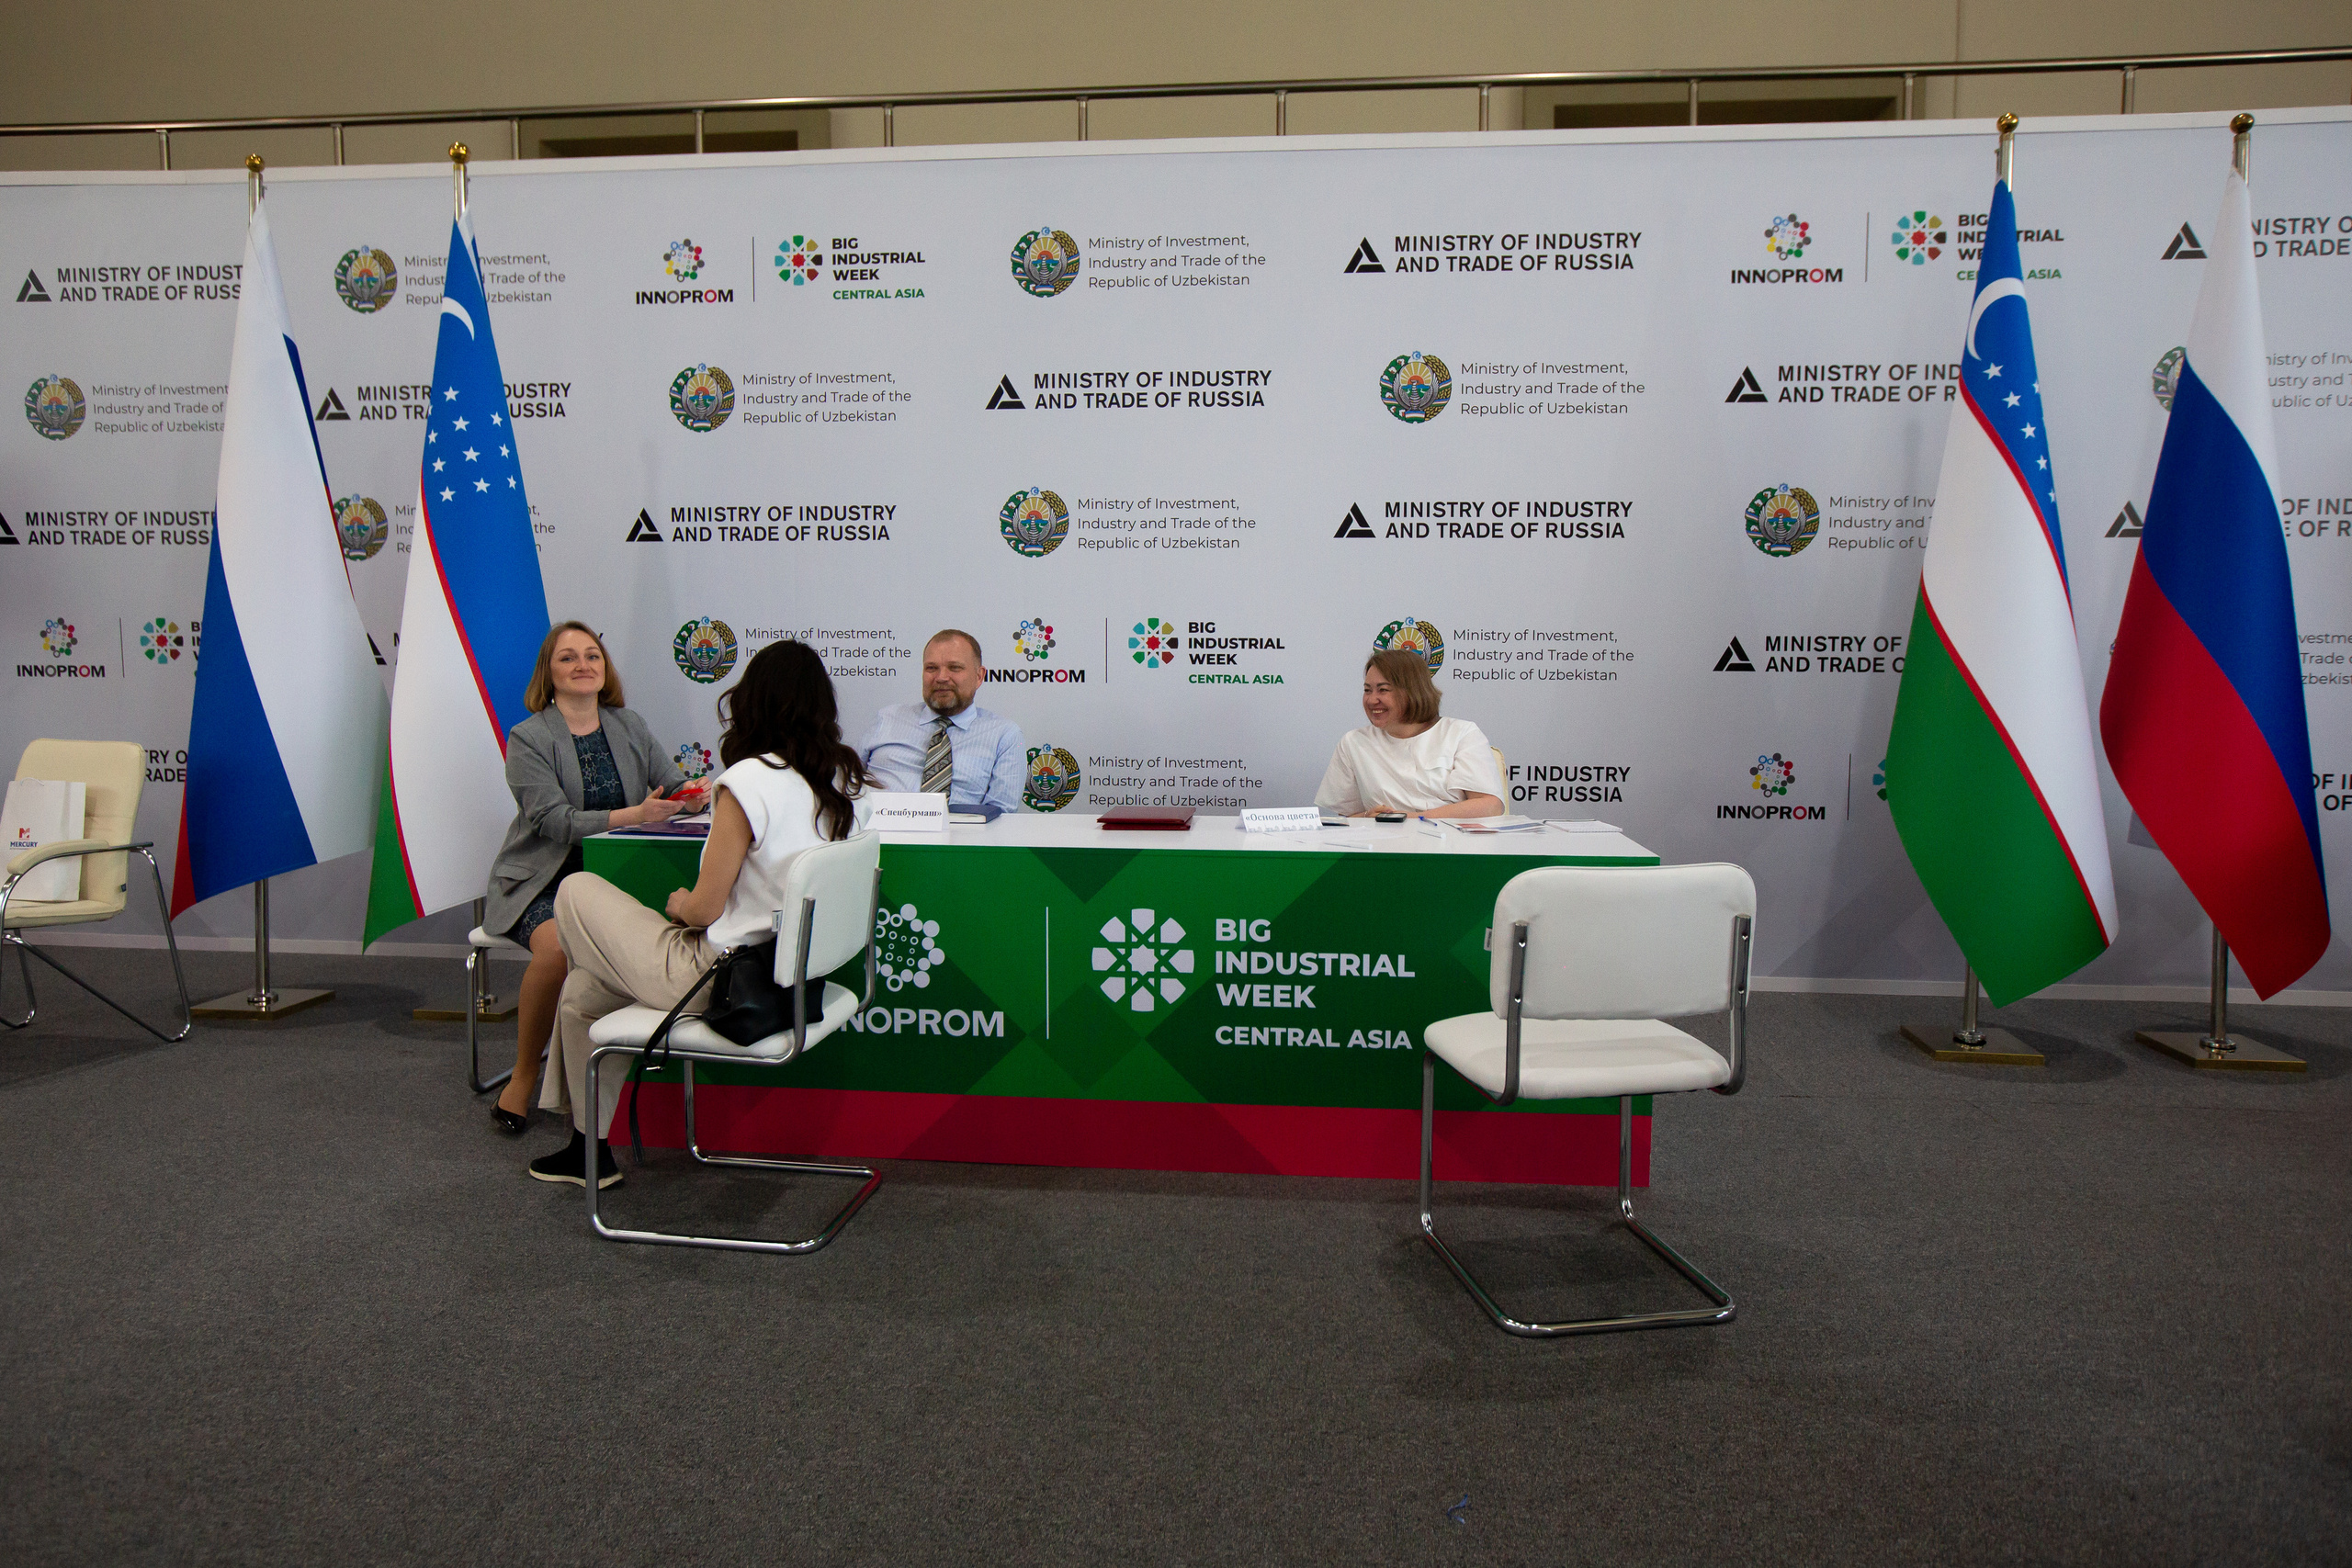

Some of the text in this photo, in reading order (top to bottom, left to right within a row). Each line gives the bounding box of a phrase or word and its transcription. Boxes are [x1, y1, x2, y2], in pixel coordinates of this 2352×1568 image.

[1958, 214, 1988, 227] BIG
[831, 237, 858, 250] BIG
[1089, 235, 1249, 251] Ministry of Investment,
[1395, 231, 1642, 252] MINISTRY OF INDUSTRY
[2275, 238, 2350, 257] TRADE
[831, 251, 926, 265] INDUSTRIAL
[1089, 254, 1266, 270] Industry and Trade of the
[1396, 253, 1634, 273] AND TRADE OF RUSSIA
[57, 265, 243, 283] MINISTRY OF INDUST
[832, 268, 880, 281] WEEK
[1089, 274, 1250, 290] Republic of Uzbekistan
[1731, 267, 1844, 284] INNOPROM
[2027, 269, 2063, 280] ASIA
[60, 284, 241, 302] AND TRADE OF RUSS
[635, 288, 734, 305] INNOPROM
[832, 288, 925, 300] CENTRAL ASIA
[1462, 362, 1628, 377] Ministry of Investment,
[1778, 365, 1882, 382] MINISTRY
[1888, 364, 1917, 380] OF
[742, 372, 895, 387] Ministry of Investment,
[1034, 370, 1272, 389] MINISTRY OF INDUSTRY
[1462, 381, 1645, 397] Industry and Trade of the
[1778, 385, 1938, 403] AND TRADE OF
[743, 390, 911, 406] Industry and Trade of the
[1035, 390, 1265, 410] AND TRADE OF RUSSIA
[1461, 401, 1628, 417] Republic of Uzbekistan
[743, 410, 896, 425] Republic of Uzbekistan
[1078, 497, 1239, 512] Ministry of Investment,
[1385, 501, 1634, 518] MINISTRY OF INDUSTRY
[26, 511, 215, 526] MINISTRY OF INDUST
[671, 505, 897, 523] MINISTRY OF INDUSTRY
[1078, 517, 1256, 532] Industry and Trade of the
[1385, 522, 1625, 539] AND TRADE OF RUSSIA
[28, 529, 209, 546] AND TRADE OF RUSS
[672, 525, 890, 542] AND TRADE OF RUSSIA
[1078, 536, 1239, 551] Republic of Uzbekistan
[745, 627, 896, 642] Ministry of Investment,
[1188, 622, 1216, 634] BIG
[1453, 629, 1617, 643] Ministry of Investment,
[1188, 637, 1285, 649] INDUSTRIAL
[1766, 636, 1902, 653] MINISTRY OF
[1189, 653, 1238, 665] WEEK
[1453, 649, 1634, 663] Industry and Trade of the
[2300, 652, 2345, 664] Trade
[17, 664, 106, 678] INNOPROM
[1765, 656, 1885, 673] AND TRADE
[984, 669, 1085, 683] INNOPROM
[1188, 674, 1284, 684] CENTRAL ASIA
[1453, 668, 1617, 682] Republic of Uzbekistan
[1089, 756, 1246, 771] Ministry of Investment,
[1090, 775, 1262, 789] Industry and Trade of the
[1527, 765, 1631, 783] INDUSTRY
[1089, 794, 1247, 807] Republic of Uzbekistan
[1511, 785, 1623, 803] OF RUSSIA
[1717, 806, 1826, 820] INNOPROM
[1216, 919, 1271, 942] BIG
[1216, 951, 1416, 977] INDUSTRIAL
[1216, 983, 1317, 1009] WEEK
[841, 1006, 1004, 1037] NOPROM
[1215, 1025, 1413, 1049] CENTRAL ASIA
